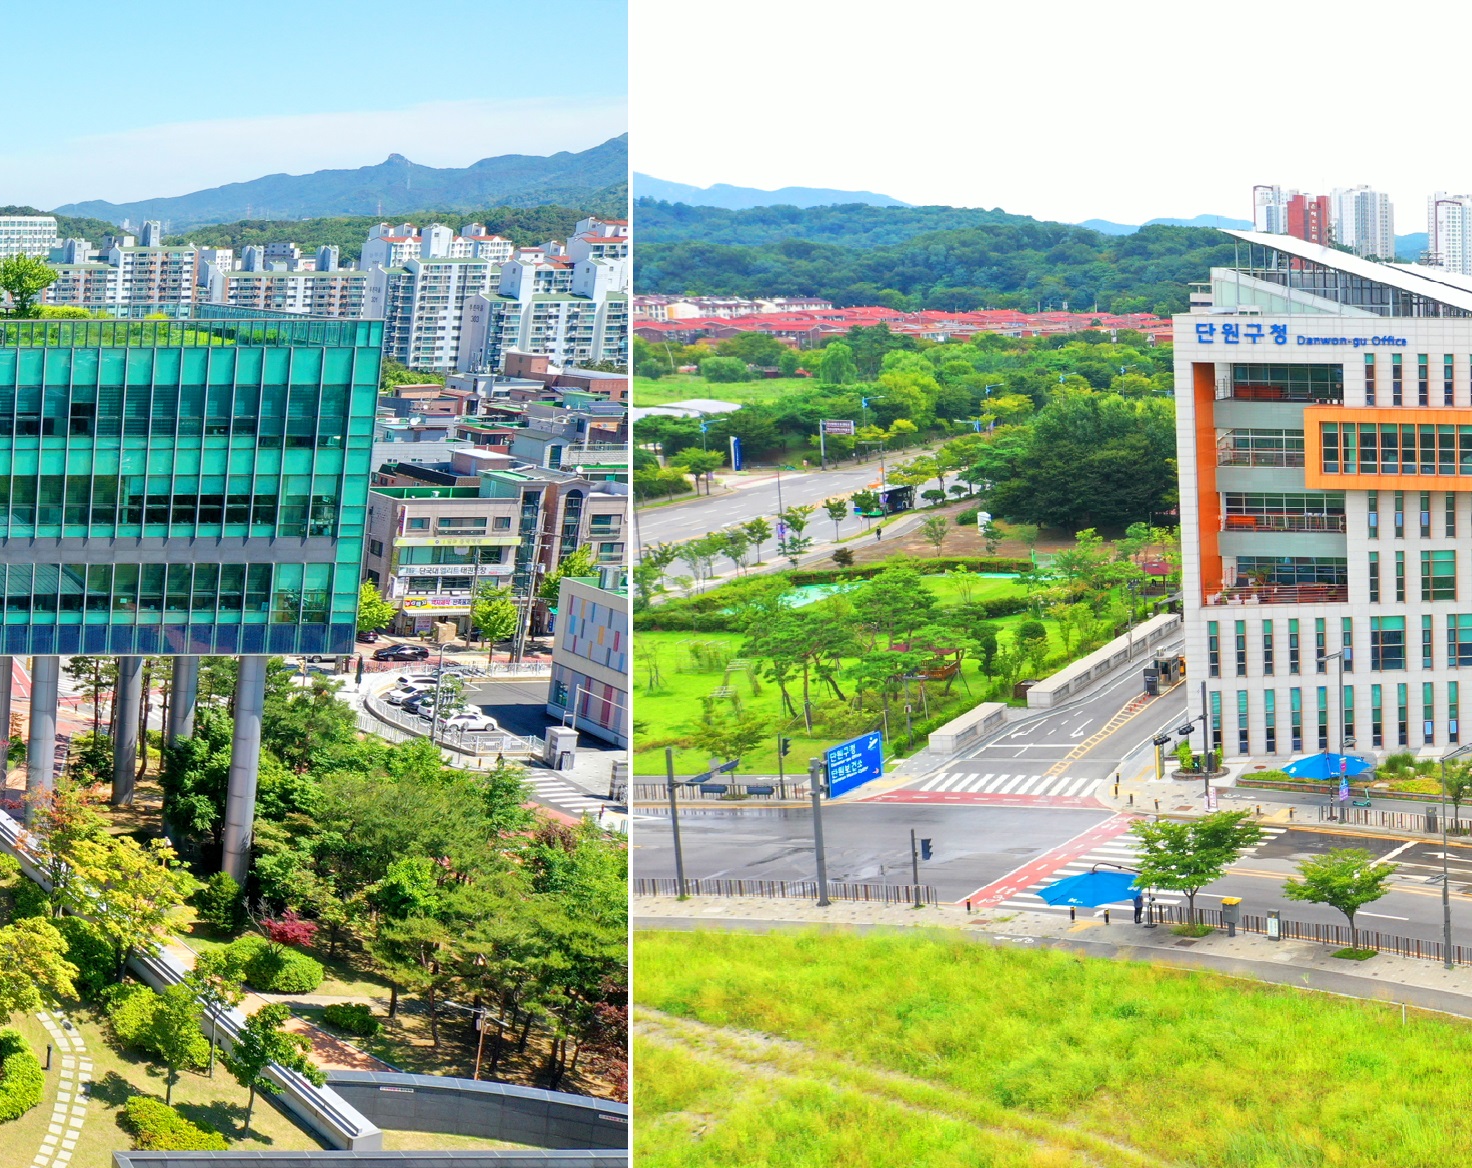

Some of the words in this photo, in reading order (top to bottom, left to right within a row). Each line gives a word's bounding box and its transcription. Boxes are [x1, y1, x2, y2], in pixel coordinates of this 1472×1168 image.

[1195, 323, 1288, 345] 단원구청
[1297, 335, 1367, 348] Danwon-gu
[1371, 335, 1407, 347] Office
[830, 744, 856, 763] 단원구청
[831, 760, 863, 779] 단원보건소
